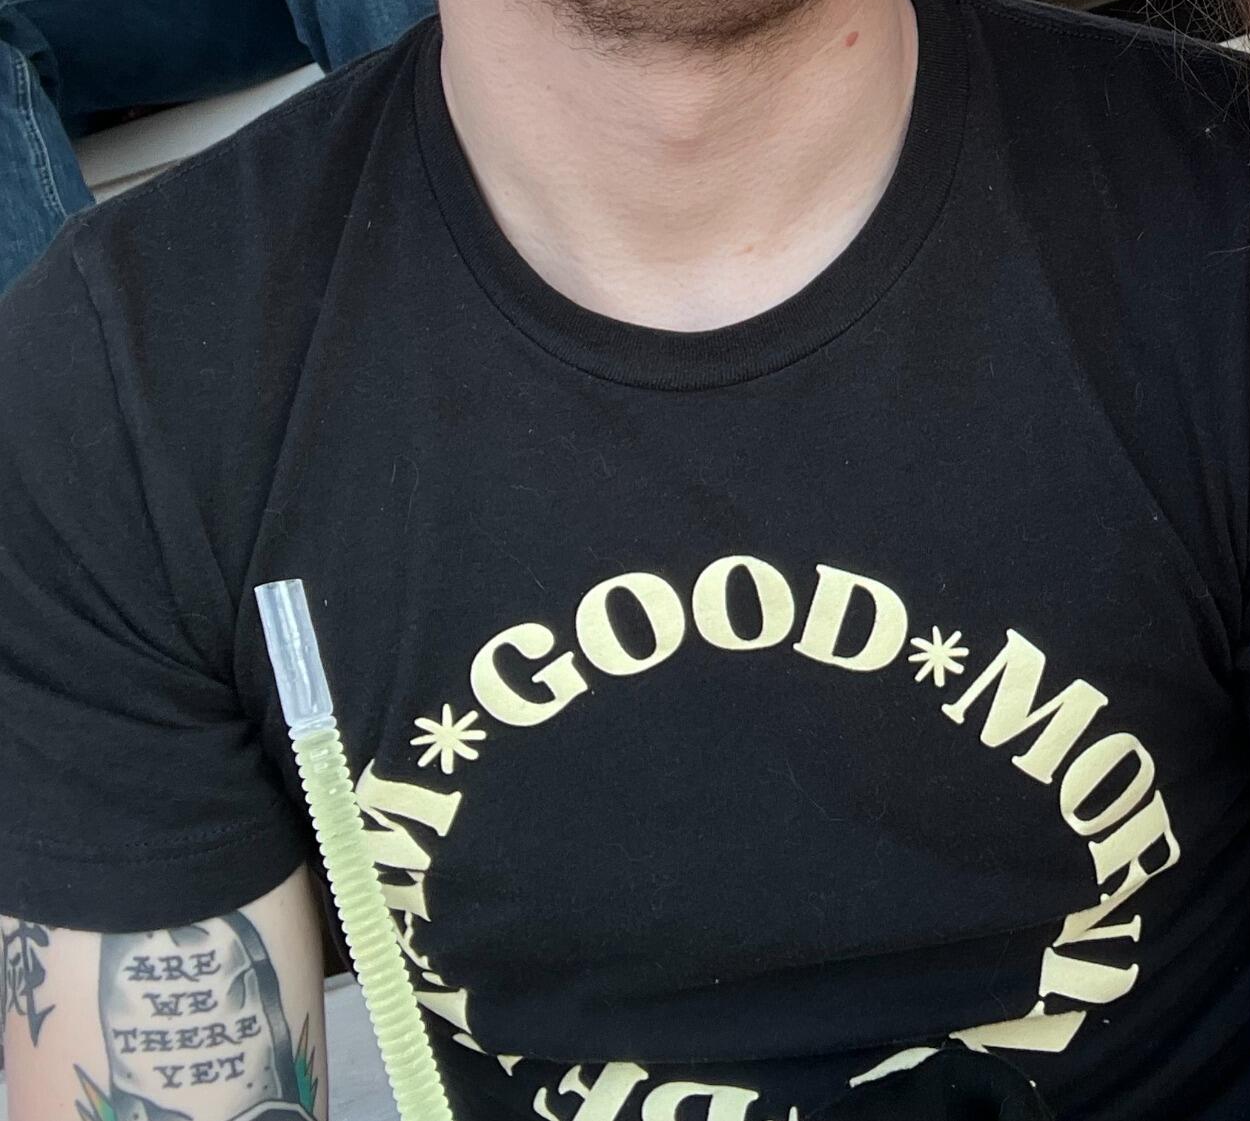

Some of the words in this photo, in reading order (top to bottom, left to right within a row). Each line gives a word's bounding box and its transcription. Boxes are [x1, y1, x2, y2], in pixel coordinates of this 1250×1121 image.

[469, 554, 909, 728] GOOD
[840, 627, 1182, 1085] MORNI
[122, 949, 222, 982] ARE
[142, 989, 218, 1017] WE
[111, 1015, 262, 1054] THERE
[153, 1052, 246, 1089] YET
